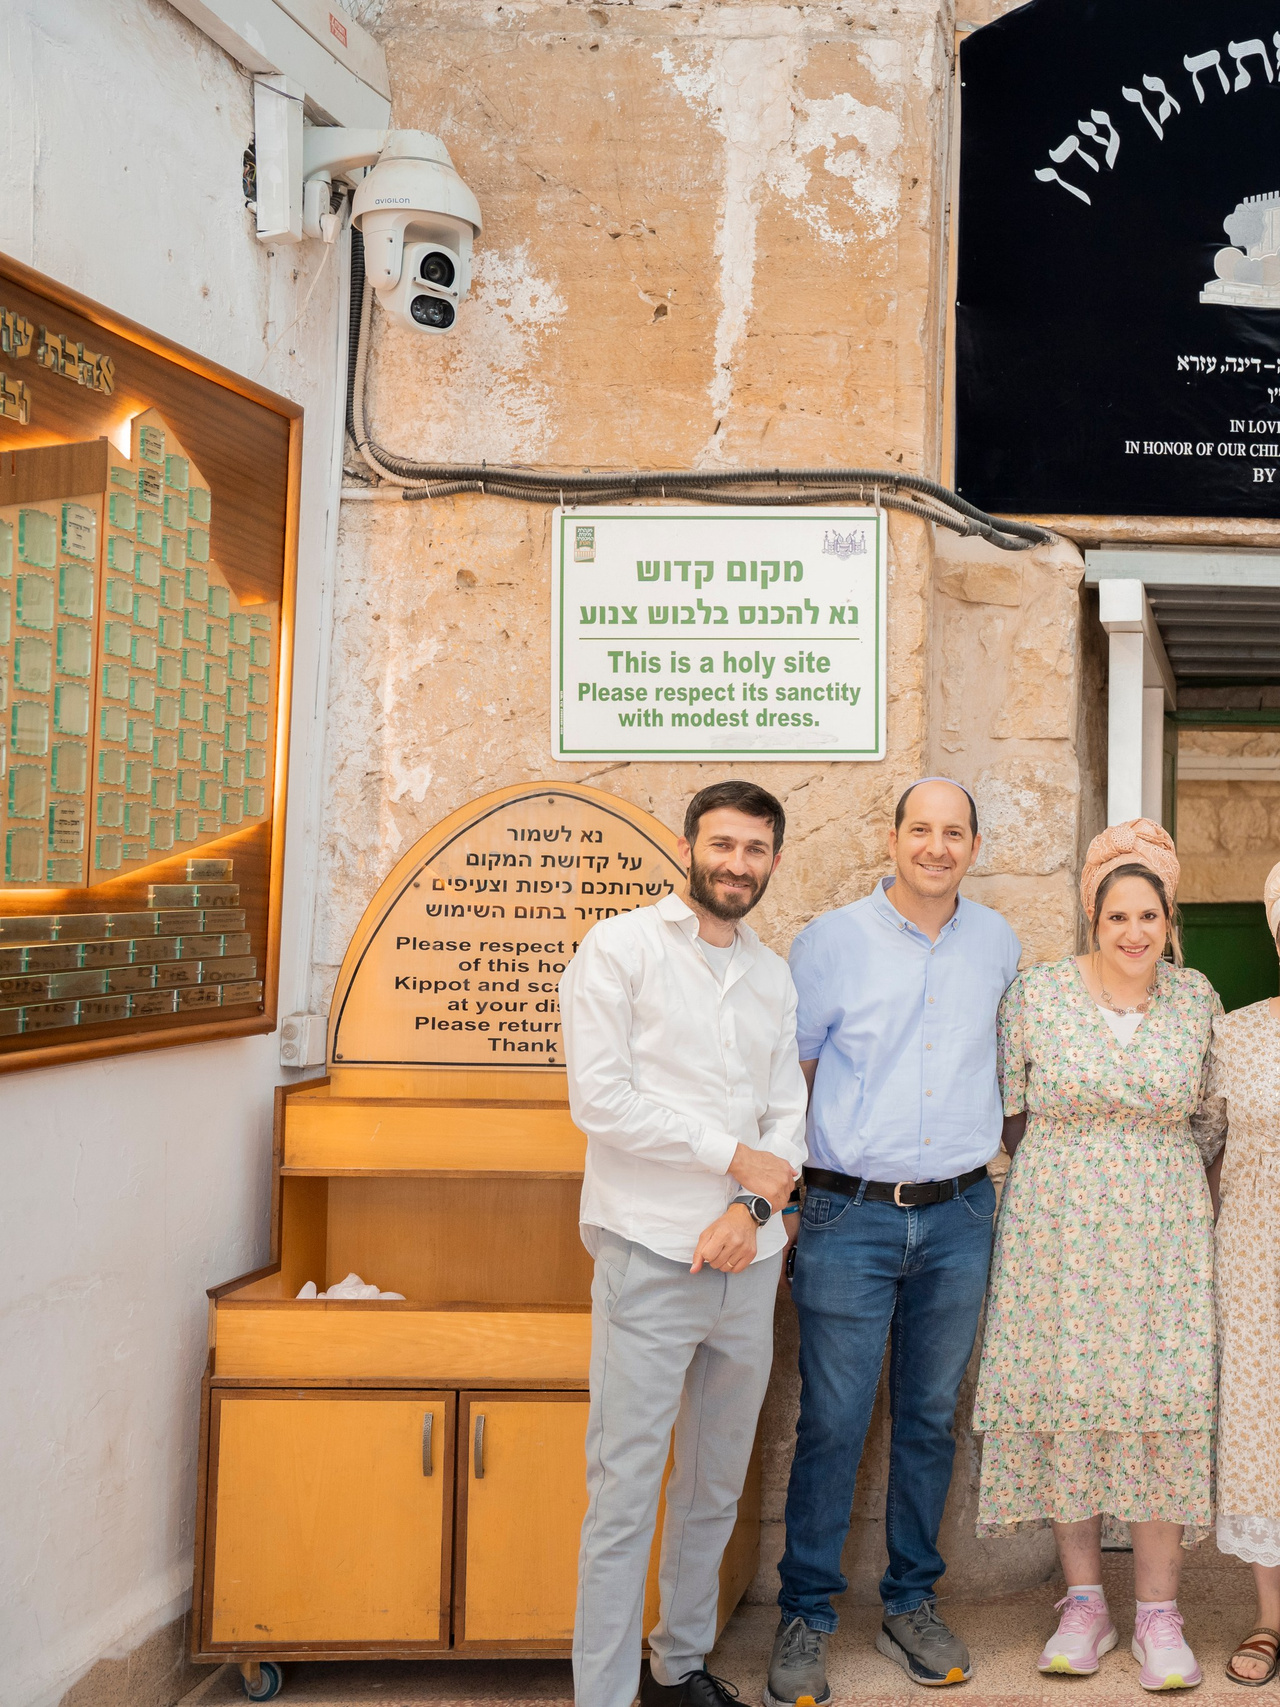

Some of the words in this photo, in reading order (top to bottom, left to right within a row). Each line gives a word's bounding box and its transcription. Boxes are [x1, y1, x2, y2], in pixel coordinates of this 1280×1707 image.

[1122, 73, 1181, 141] גן
[1034, 108, 1121, 206] עדן
[39, 325, 115, 395] אהבת
[1177, 355, 1217, 374] עזרא
[1229, 419, 1246, 433] IN
[1124, 440, 1141, 454] IN
[1142, 441, 1193, 456] HONOR
[1195, 441, 1215, 456] OF
[1217, 442, 1247, 457] OUR
[1252, 467, 1277, 483] BY
[636, 560, 715, 590] קדוש
[726, 560, 804, 590] מקום
[579, 605, 638, 625] צנוע
[648, 597, 729, 625] בלבוש
[739, 597, 820, 625] להכנס
[829, 605, 859, 625] נא
[607, 650, 662, 674] This
[670, 651, 692, 674] is
[699, 656, 715, 674] a
[723, 650, 776, 680] holy
[784, 650, 831, 674] site
[578, 682, 648, 702] Please
[655, 683, 735, 707] respect
[742, 681, 769, 702] its
[775, 681, 861, 707] sanctity
[619, 708, 664, 728] with
[671, 708, 749, 728] modest
[755, 707, 820, 728] dress.
[506, 825, 572, 843] לשמור
[580, 830, 603, 844] נא
[466, 853, 532, 871] המקום
[540, 854, 610, 874] קדושת
[617, 852, 643, 872] על
[432, 878, 508, 894] וצעיפים
[515, 880, 573, 894] כיפות
[581, 878, 675, 897] לשרותכם
[426, 904, 505, 918] השימוש
[514, 904, 566, 919] בתום
[396, 936, 472, 952] Please
[479, 940, 565, 956] respect
[458, 957, 482, 972] of
[487, 958, 530, 973] this
[394, 976, 471, 994] Kippot
[477, 978, 520, 993] and
[447, 998, 469, 1012] at
[475, 1001, 529, 1015] your
[415, 1016, 491, 1032] Please
[487, 1037, 558, 1053] Thank
